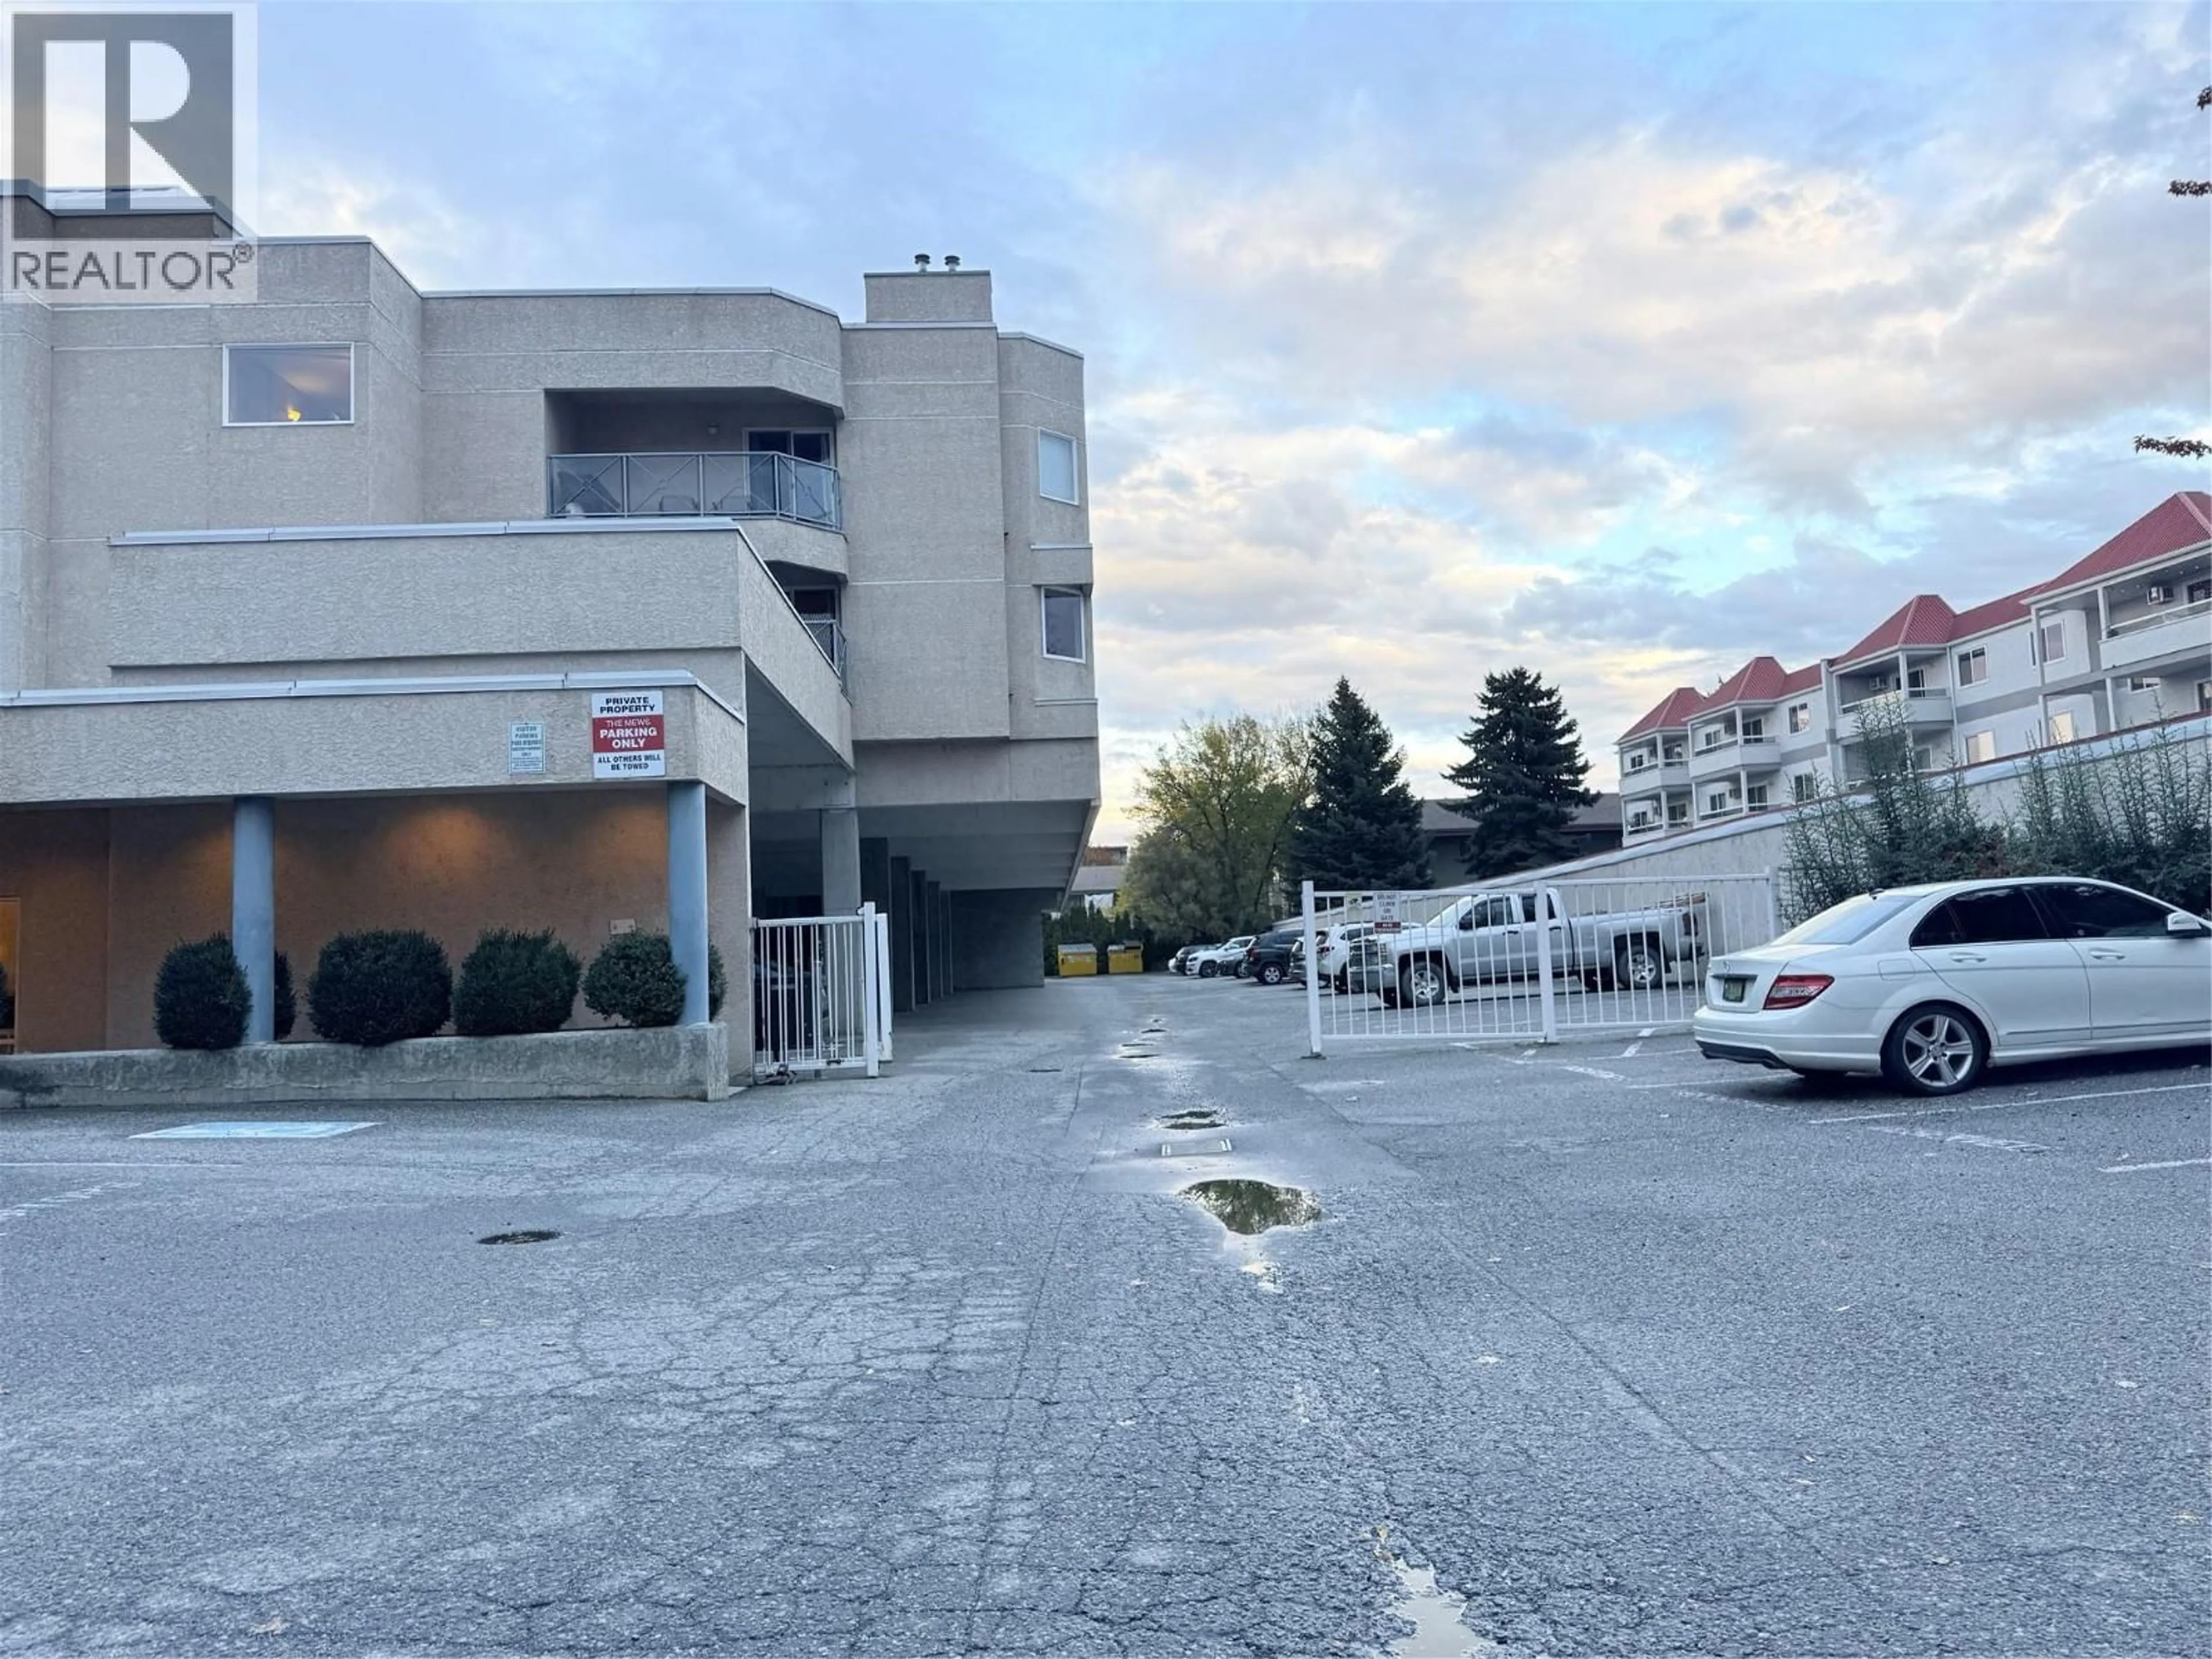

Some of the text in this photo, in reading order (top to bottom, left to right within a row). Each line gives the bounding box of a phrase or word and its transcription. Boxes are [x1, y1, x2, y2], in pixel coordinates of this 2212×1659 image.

[605, 696, 649, 706] PRIVATE
[600, 703, 656, 714] PROPERTY
[605, 719, 623, 728] THE
[600, 726, 658, 738] PARKING
[612, 738, 646, 749] ONLY
[612, 755, 642, 763] OTHERS
